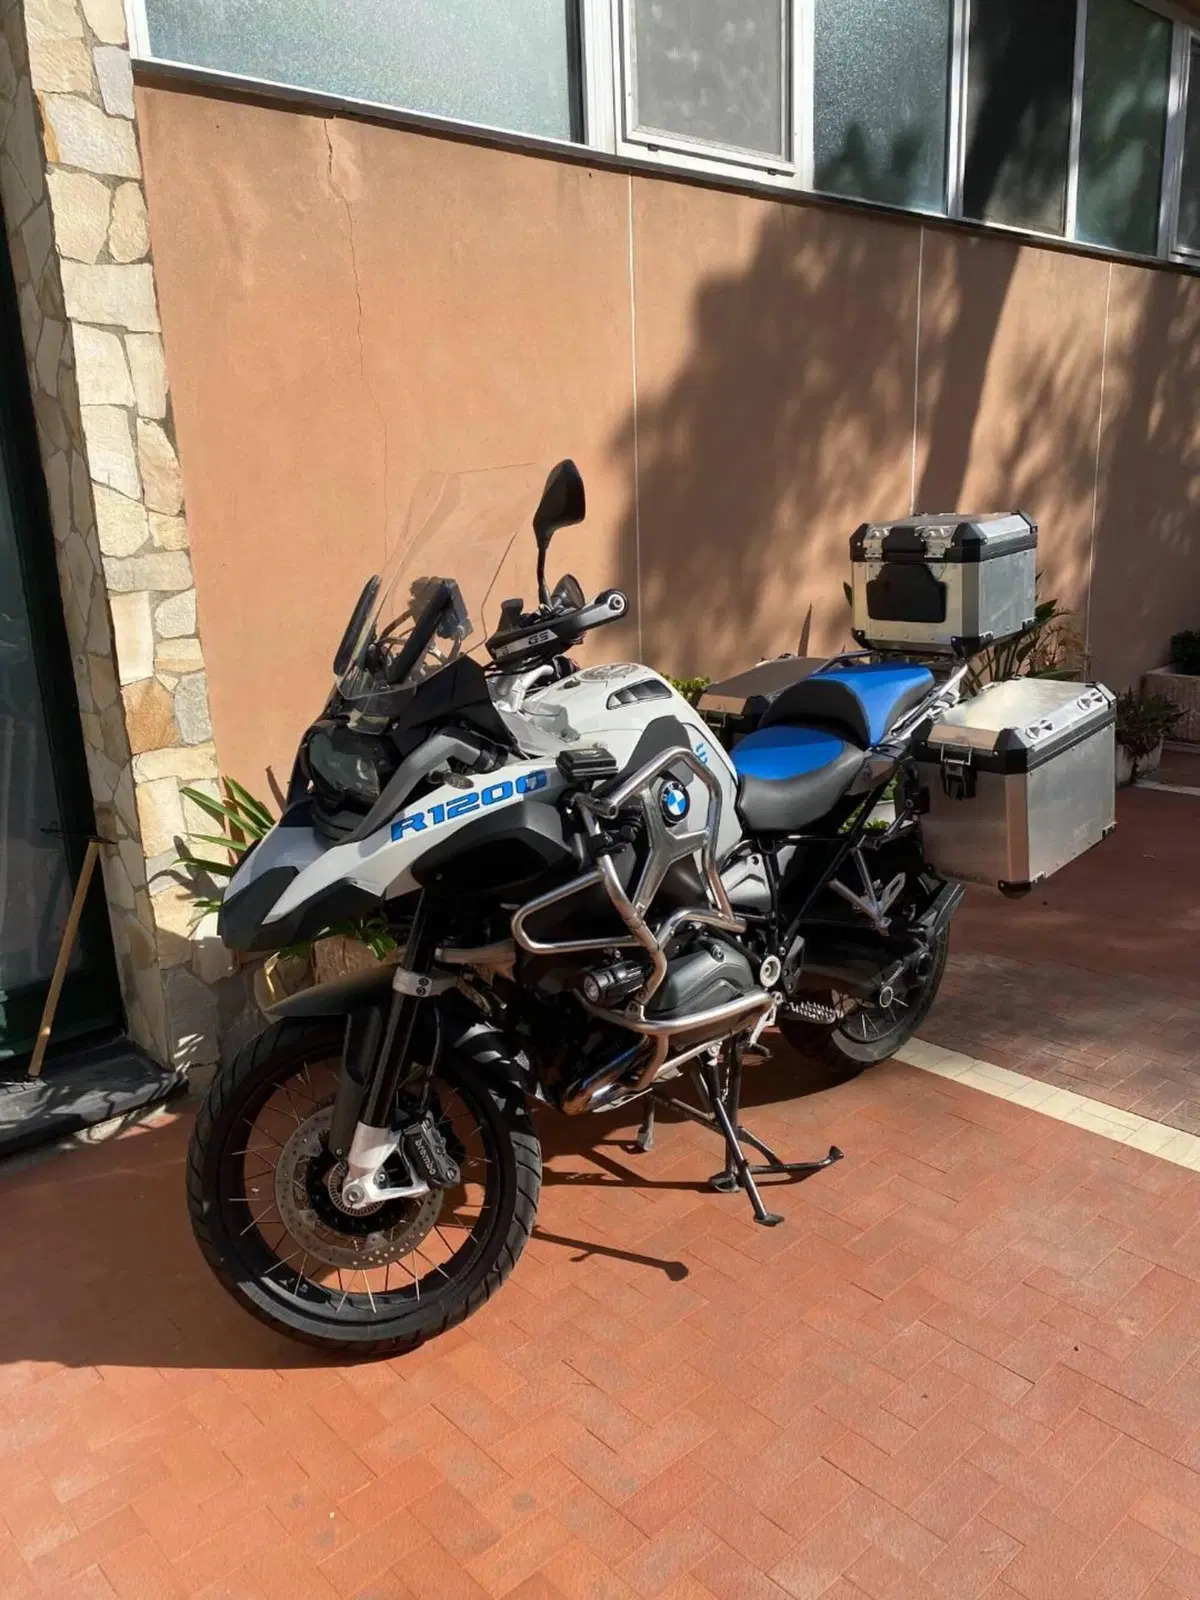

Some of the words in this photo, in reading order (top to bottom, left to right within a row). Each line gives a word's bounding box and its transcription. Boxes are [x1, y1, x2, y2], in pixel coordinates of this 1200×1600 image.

[528, 631, 549, 645] GS
[390, 769, 548, 842] R1200
[415, 1138, 436, 1175] brembo
